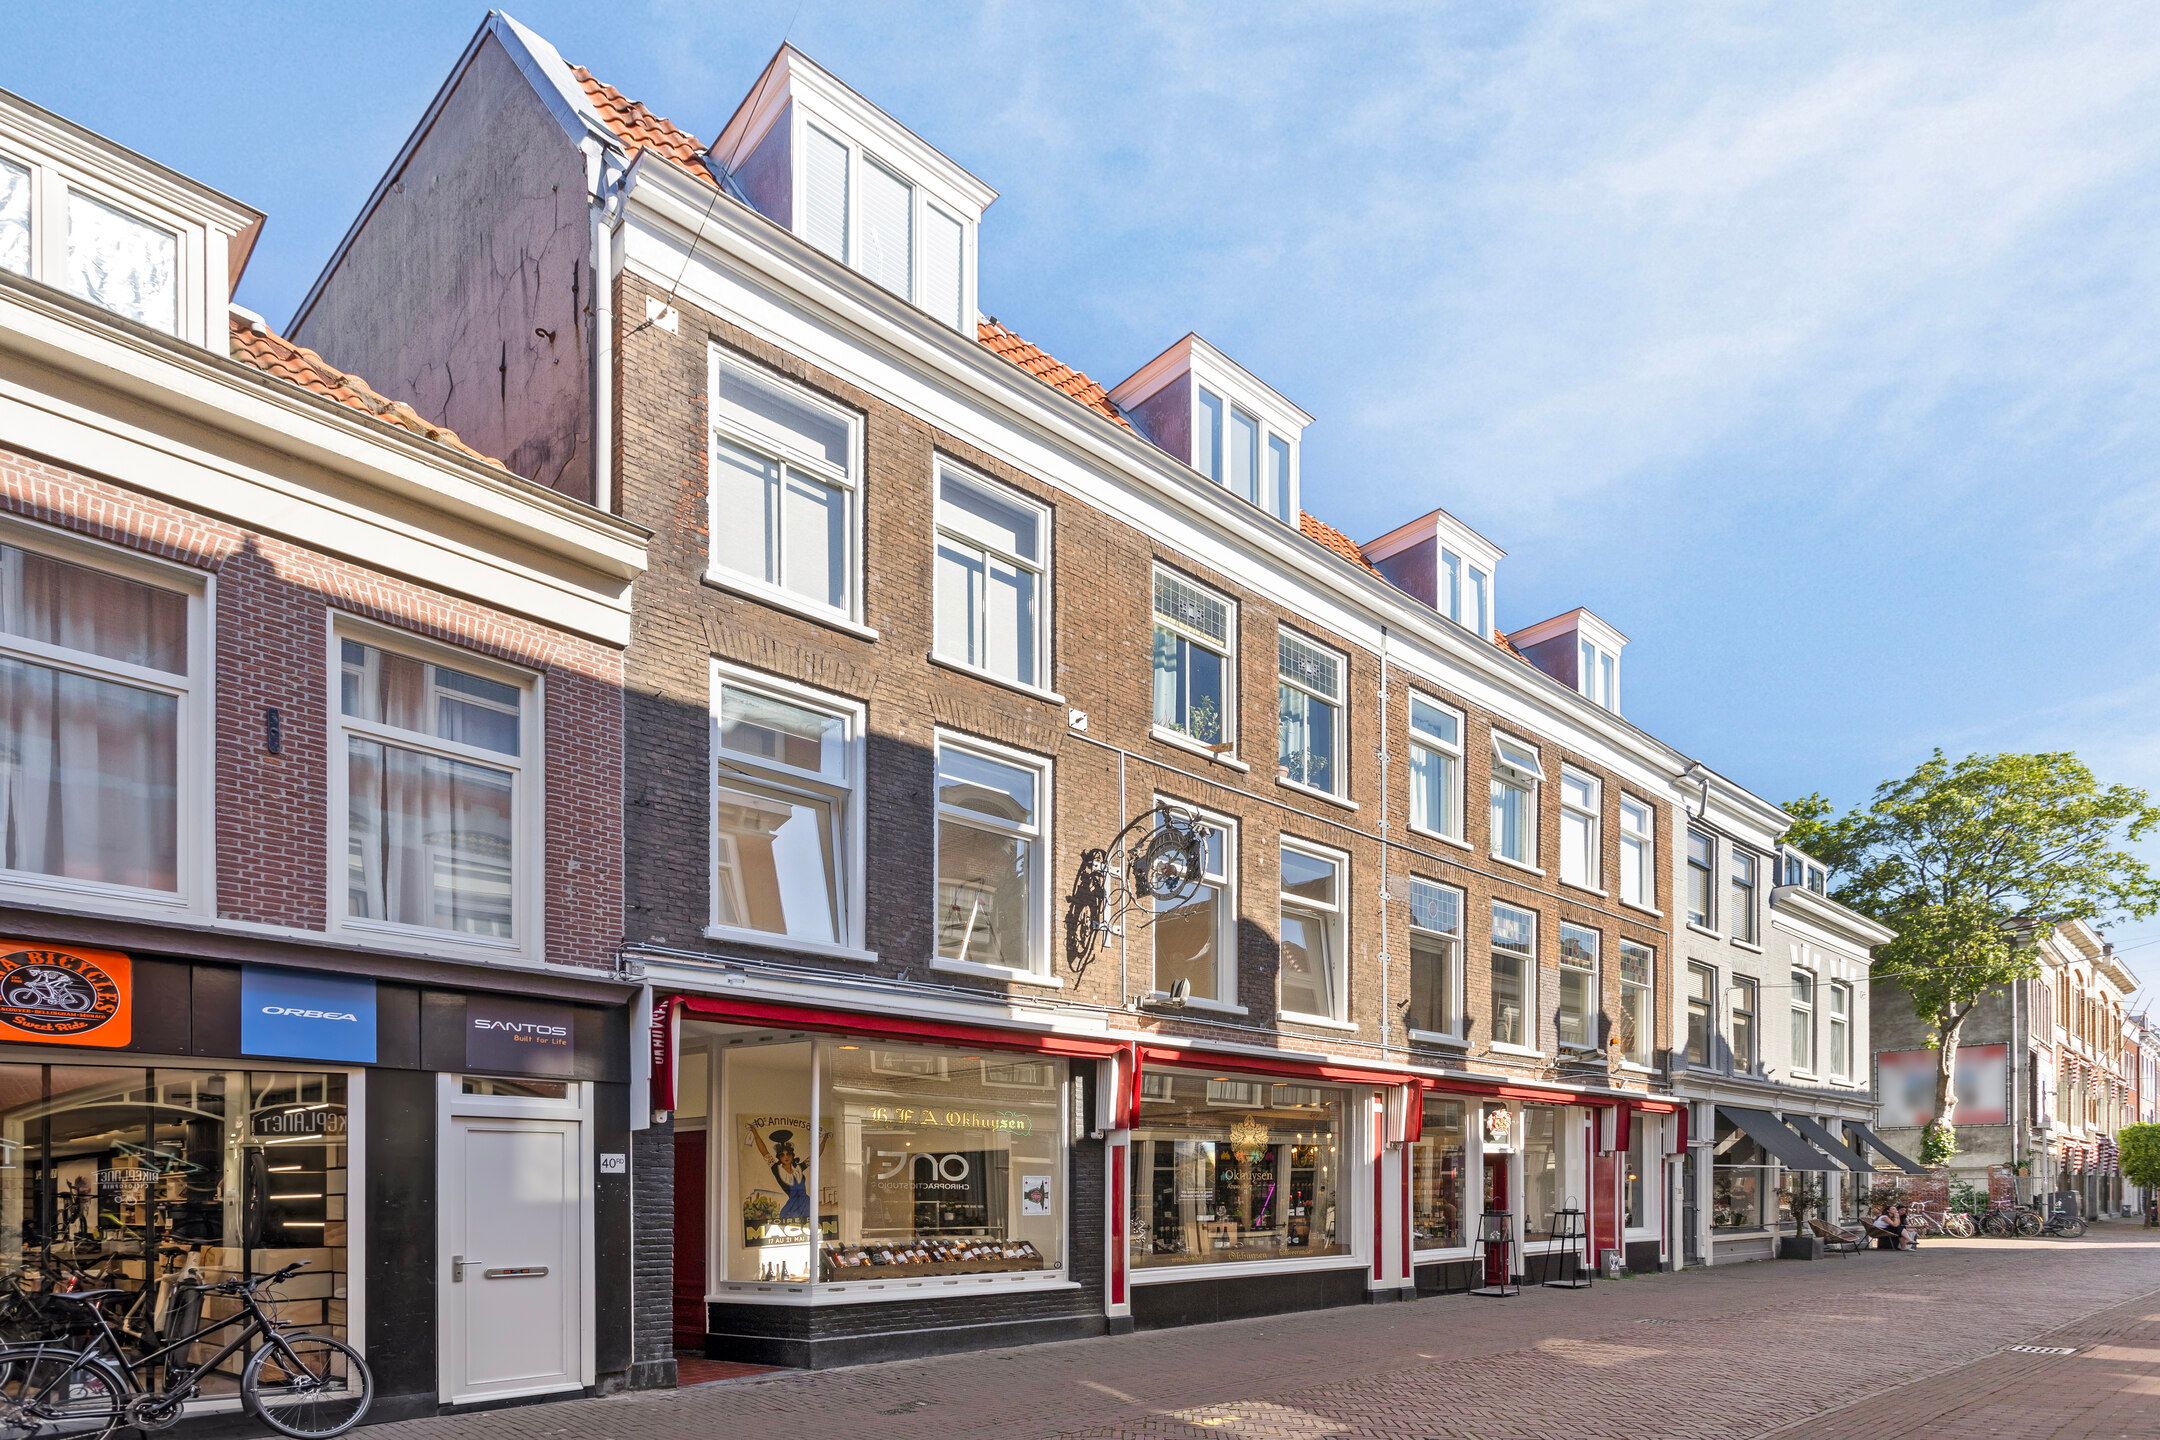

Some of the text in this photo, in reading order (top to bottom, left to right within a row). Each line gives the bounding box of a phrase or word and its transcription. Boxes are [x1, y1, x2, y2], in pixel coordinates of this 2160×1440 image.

[27, 951, 117, 1014] BICYCLES
[262, 1006, 357, 1022] ORBEA
[12, 1016, 88, 1031] Sweet Ride
[475, 1019, 567, 1036] SANTOS
[513, 1034, 532, 1042] Built
[946, 1111, 1025, 1132] Okhuysen
